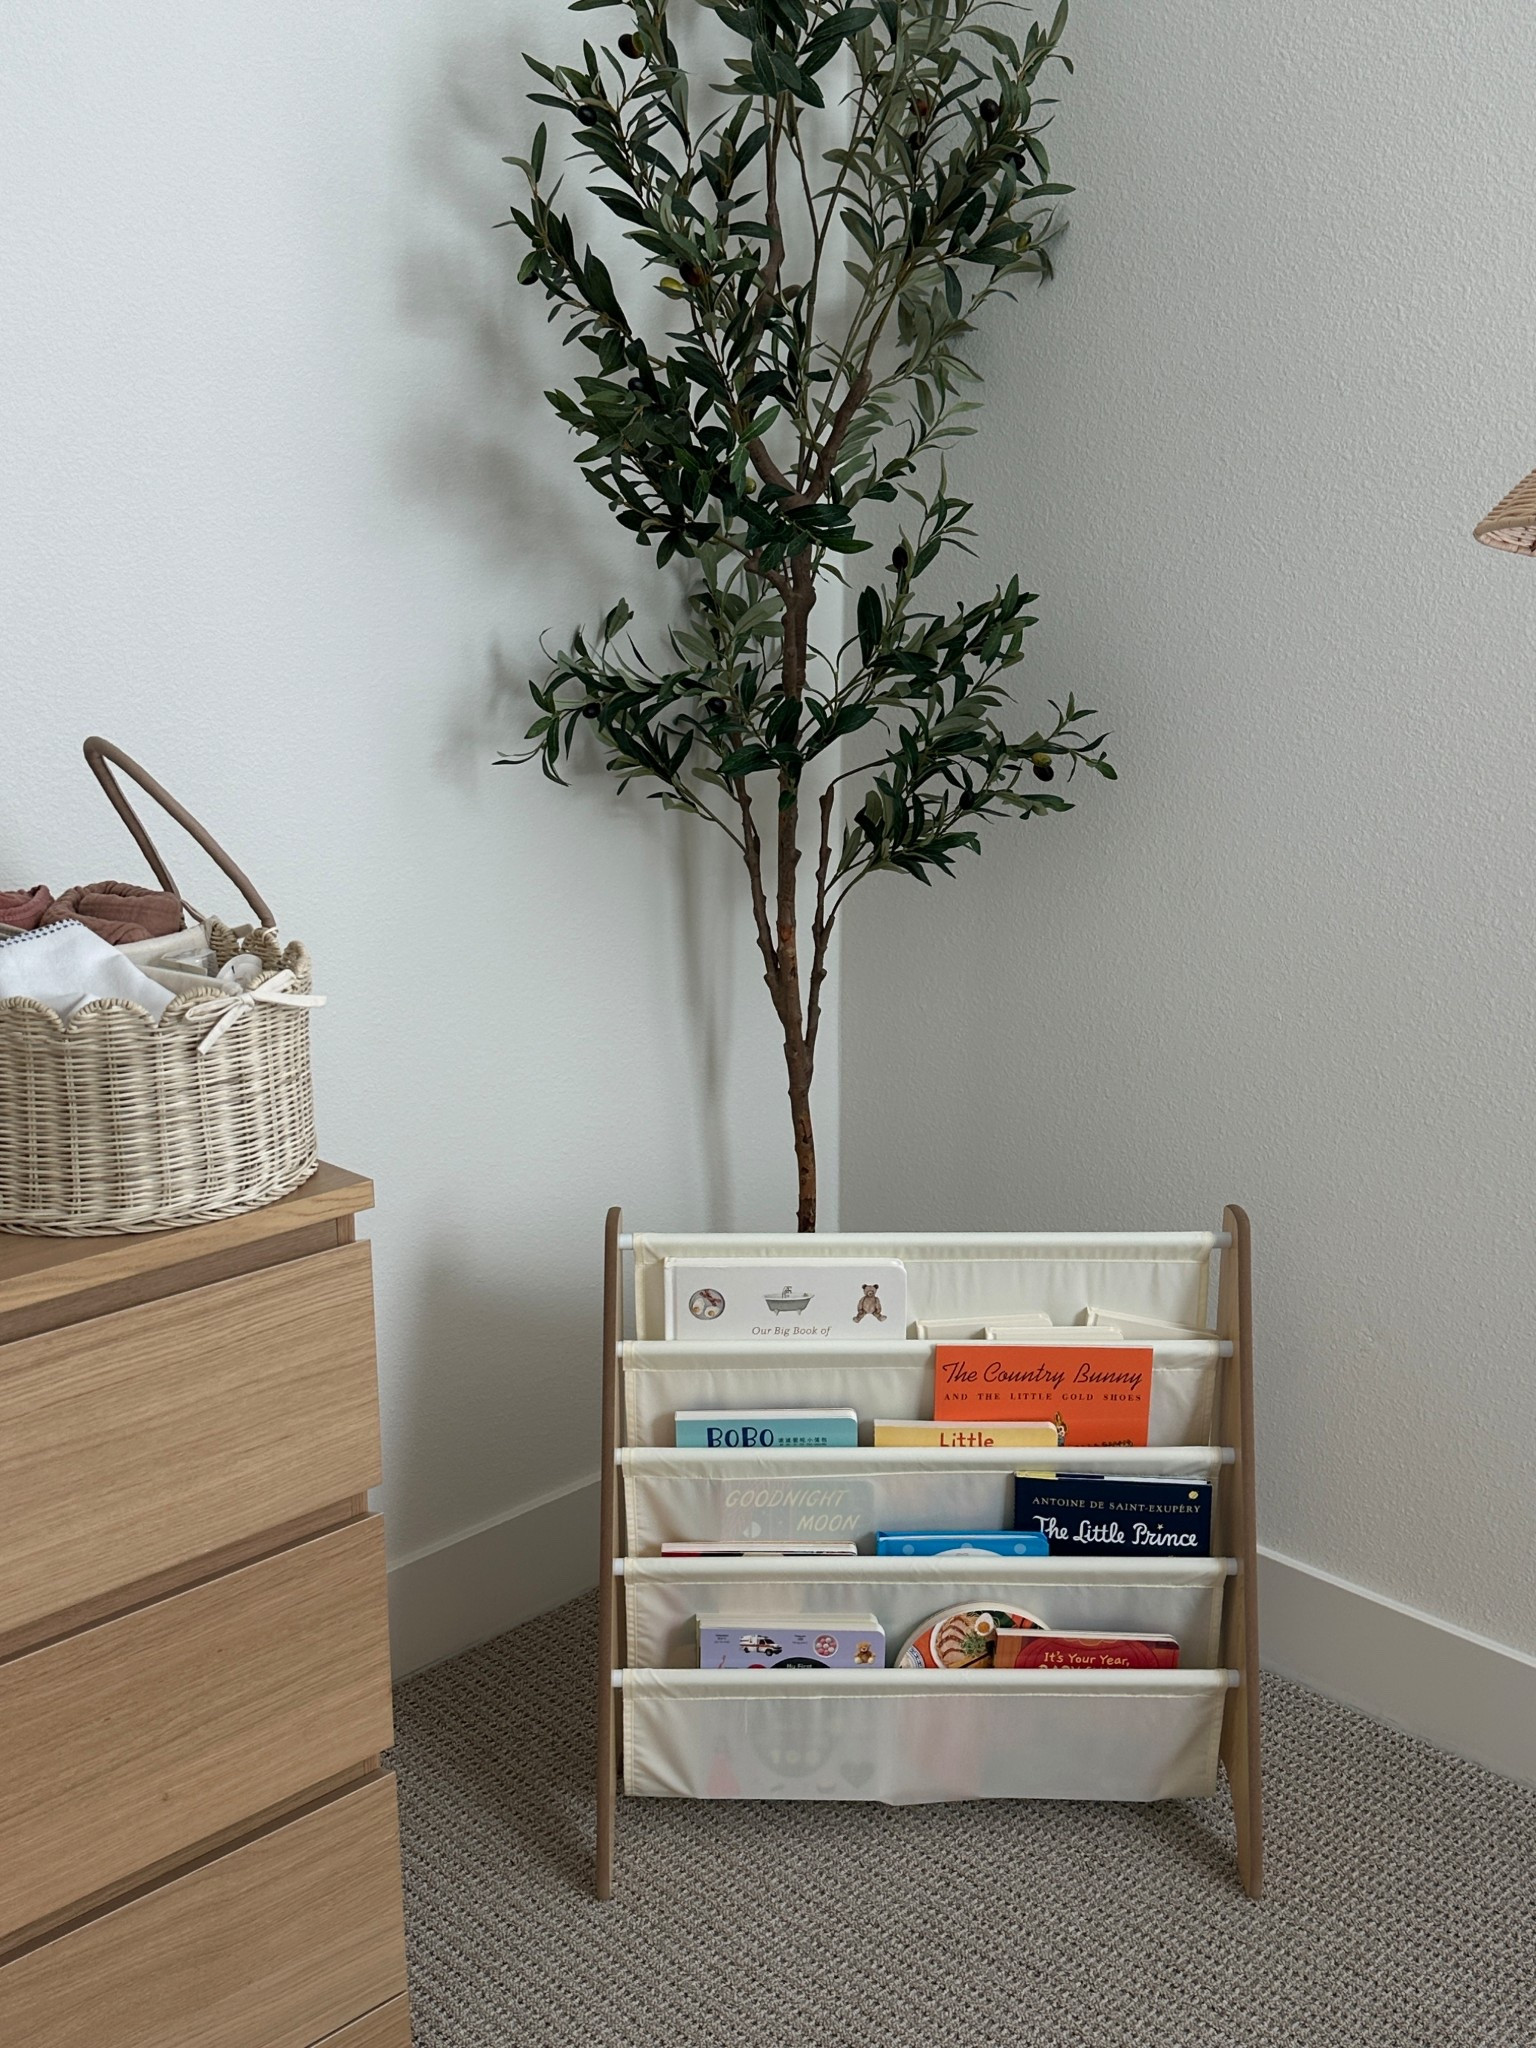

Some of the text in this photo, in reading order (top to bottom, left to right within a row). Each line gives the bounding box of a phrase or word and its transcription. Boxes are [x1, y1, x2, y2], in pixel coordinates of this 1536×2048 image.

[752, 1325, 832, 1337] Our Big Book of
[942, 1361, 1143, 1391] The Country Bunny
[1062, 1393, 1094, 1401] GOLD
[706, 1427, 774, 1448] BOBO
[940, 1431, 995, 1447] Little
[725, 1489, 849, 1508] GOODNIGHT
[1032, 1496, 1201, 1513] ANTOINE DE SAINT-EXUPÉRY
[796, 1514, 861, 1532] MOON
[1032, 1515, 1199, 1547] The Little Prince
[1044, 1651, 1130, 1666] It's Your Year,
